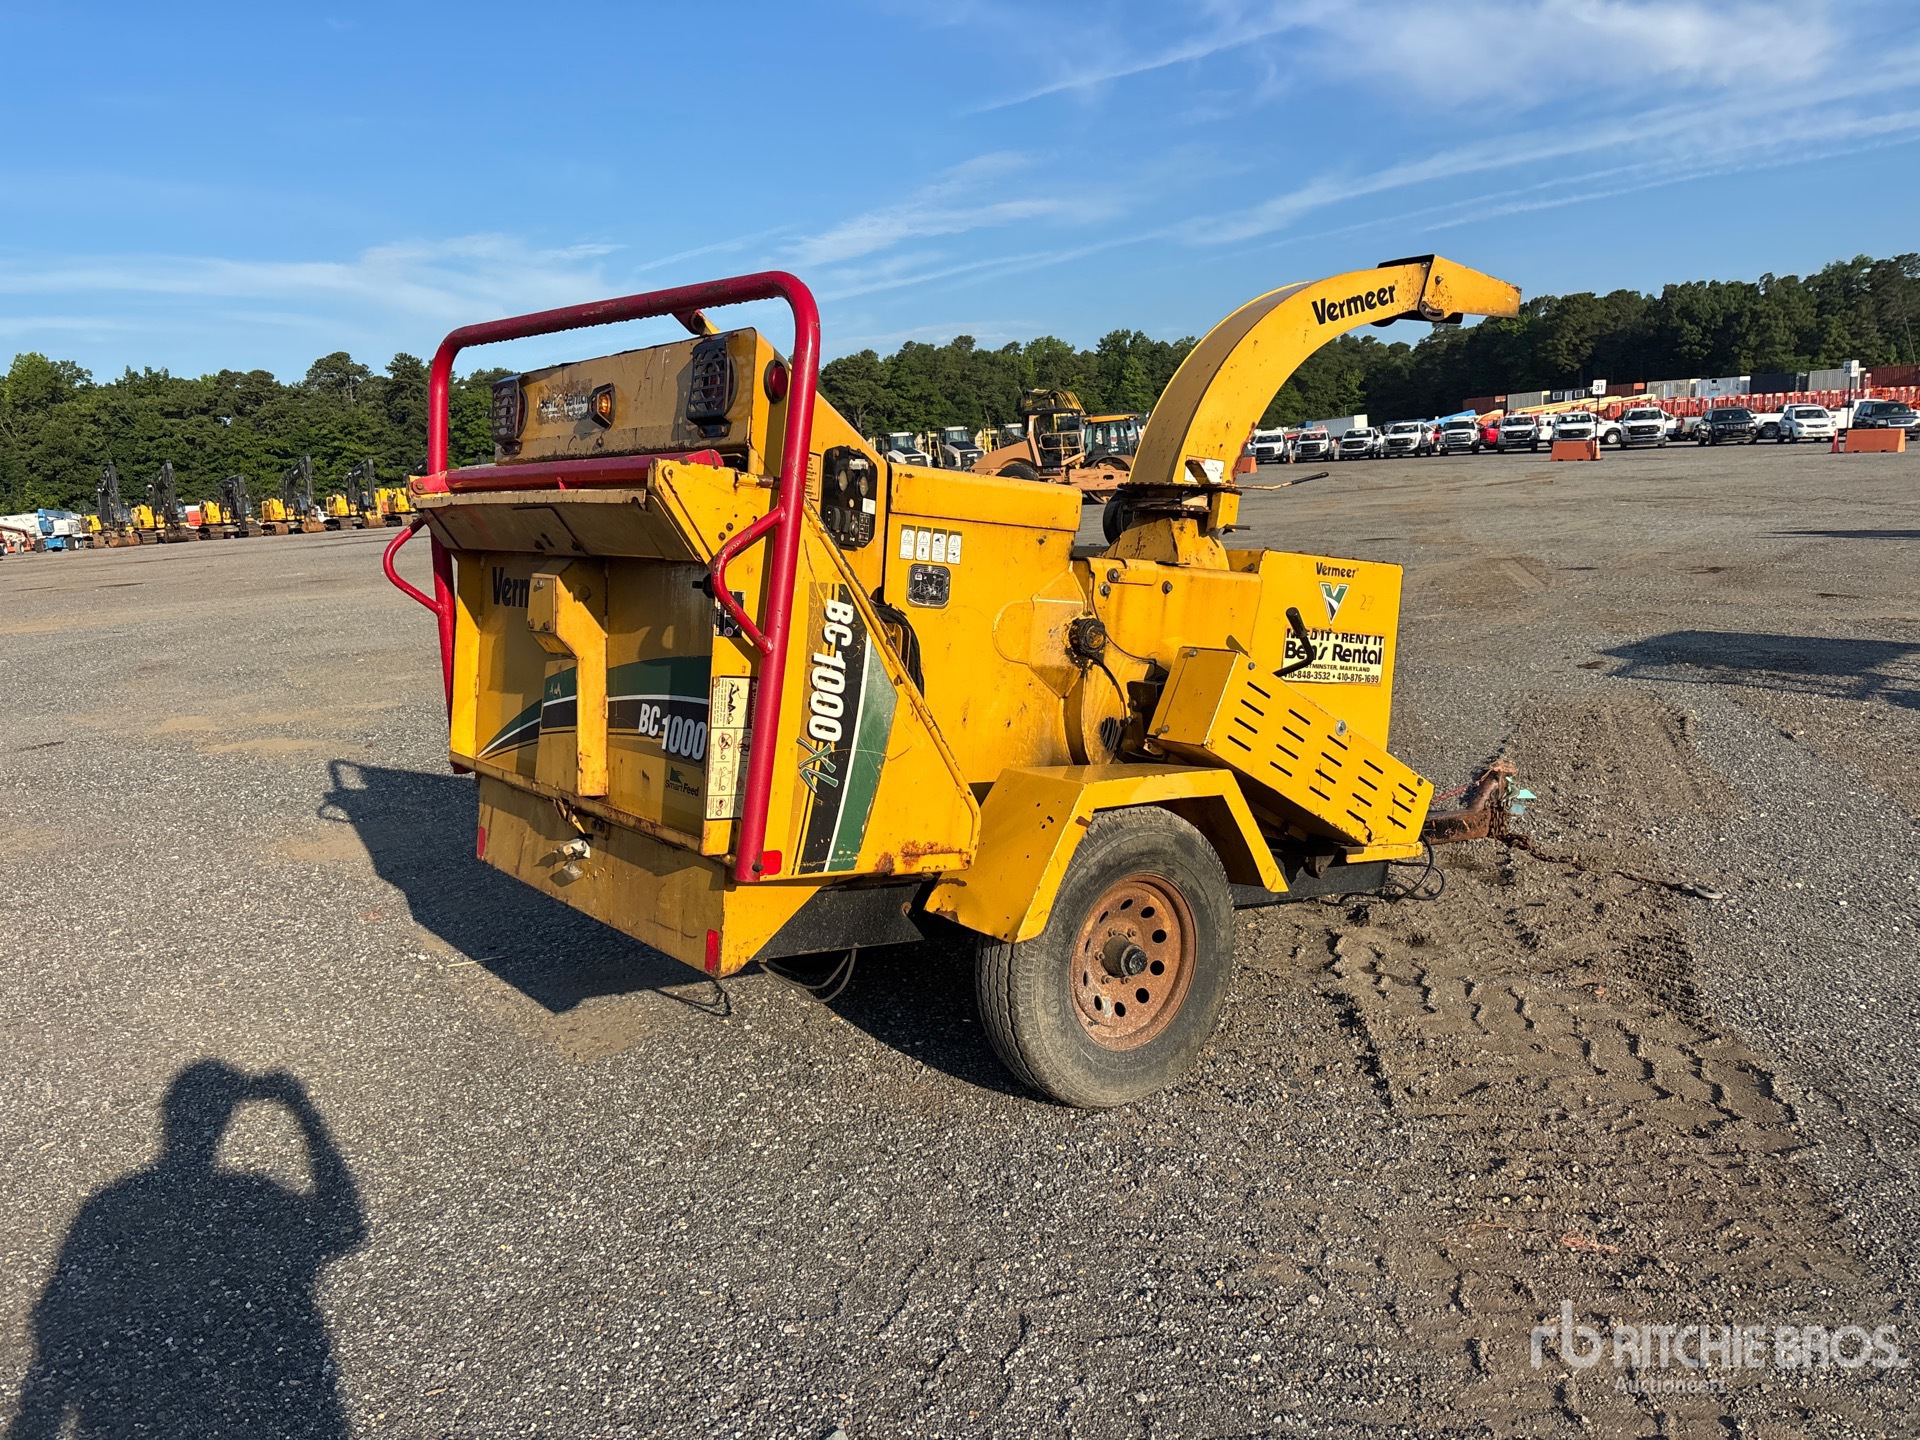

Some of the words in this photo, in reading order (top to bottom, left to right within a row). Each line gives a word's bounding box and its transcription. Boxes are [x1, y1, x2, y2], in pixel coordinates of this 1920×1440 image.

[1311, 284, 1396, 325] Vermeer
[1594, 384, 1604, 392] 31
[1316, 561, 1356, 578] Vermeer
[492, 566, 530, 608] Verm
[1320, 629, 1334, 642] IT
[1341, 632, 1370, 645] RENT
[1373, 635, 1384, 646] IT
[1332, 643, 1382, 665] Rental
[1284, 670, 1331, 680] 10-848-3532
[1337, 672, 1379, 684] 410-876-1699
